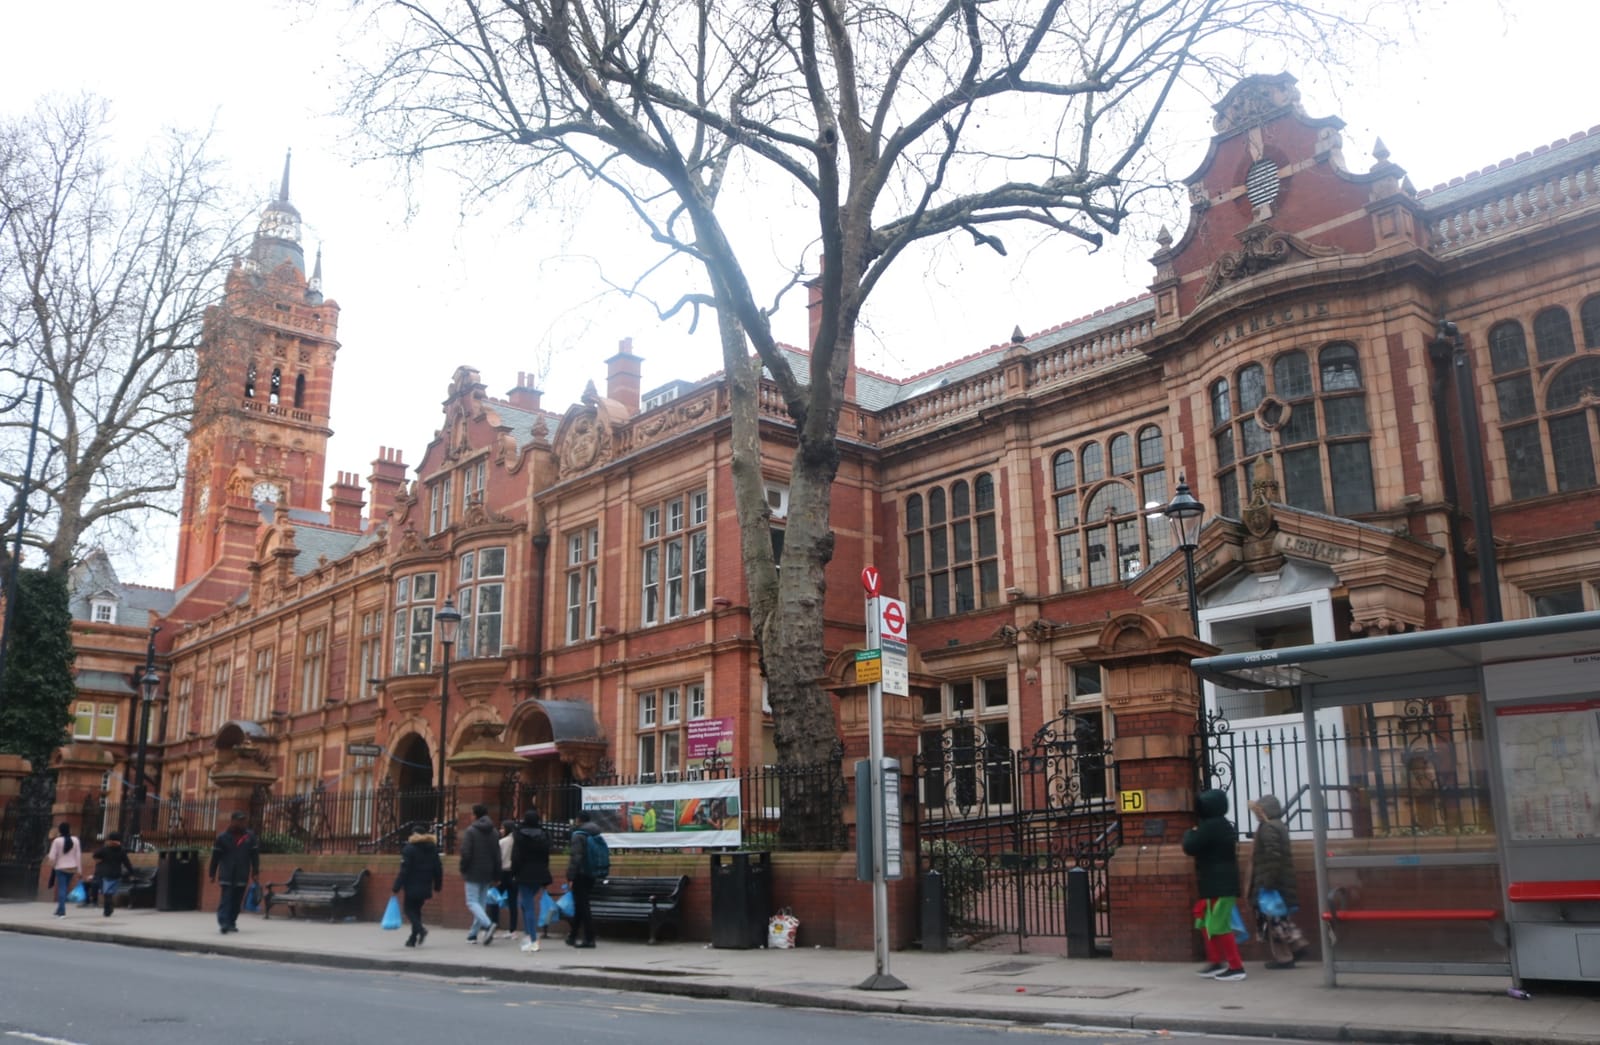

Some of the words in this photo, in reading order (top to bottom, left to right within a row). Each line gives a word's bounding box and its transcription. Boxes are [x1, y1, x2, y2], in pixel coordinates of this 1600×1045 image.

[1211, 302, 1329, 349] CARNEGIE
[1284, 536, 1347, 563] LIBRARY
[865, 570, 878, 590] V
[1122, 792, 1142, 809] HD
